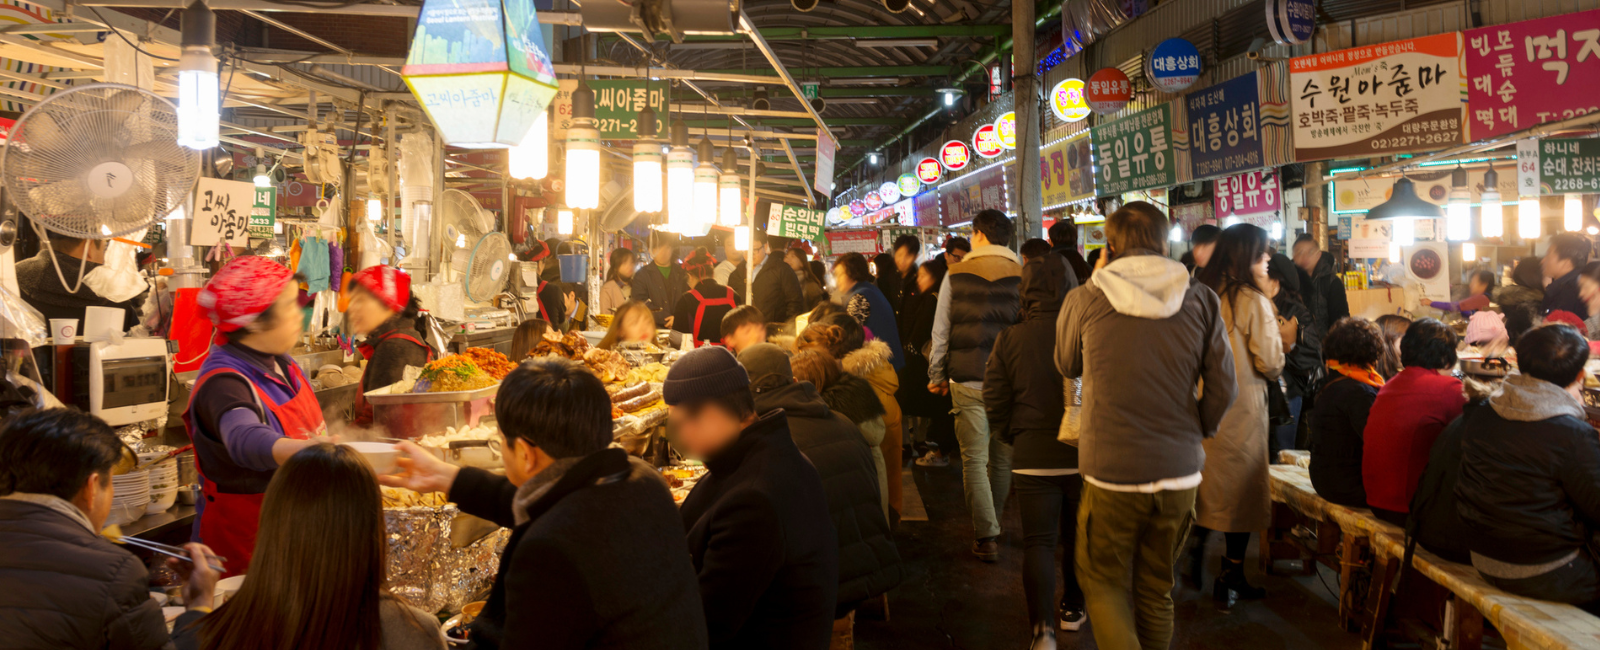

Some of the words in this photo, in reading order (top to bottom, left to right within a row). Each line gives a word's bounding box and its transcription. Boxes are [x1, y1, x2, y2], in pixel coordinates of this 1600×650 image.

[1154, 54, 1199, 72] 대흥상회
[1091, 80, 1130, 95] 동일유통
[1300, 63, 1447, 109] 수원아줌마
[1470, 33, 1495, 130] 빈대떡
[1494, 30, 1518, 128] 모듬순대
[426, 88, 498, 108] 고씨아줌마
[1192, 101, 1258, 154] 대흥상회
[1402, 118, 1459, 134] 대량주문환영
[1371, 131, 1459, 150] 02)2271-2627
[1544, 142, 1580, 155] 하니네
[1098, 125, 1168, 182] 동일유통
[1521, 161, 1536, 173] 64
[202, 190, 230, 212] 고씨
[1217, 171, 1277, 213] 동일유통
[783, 206, 824, 227] 순희네
[785, 222, 820, 236] 빈대떡
